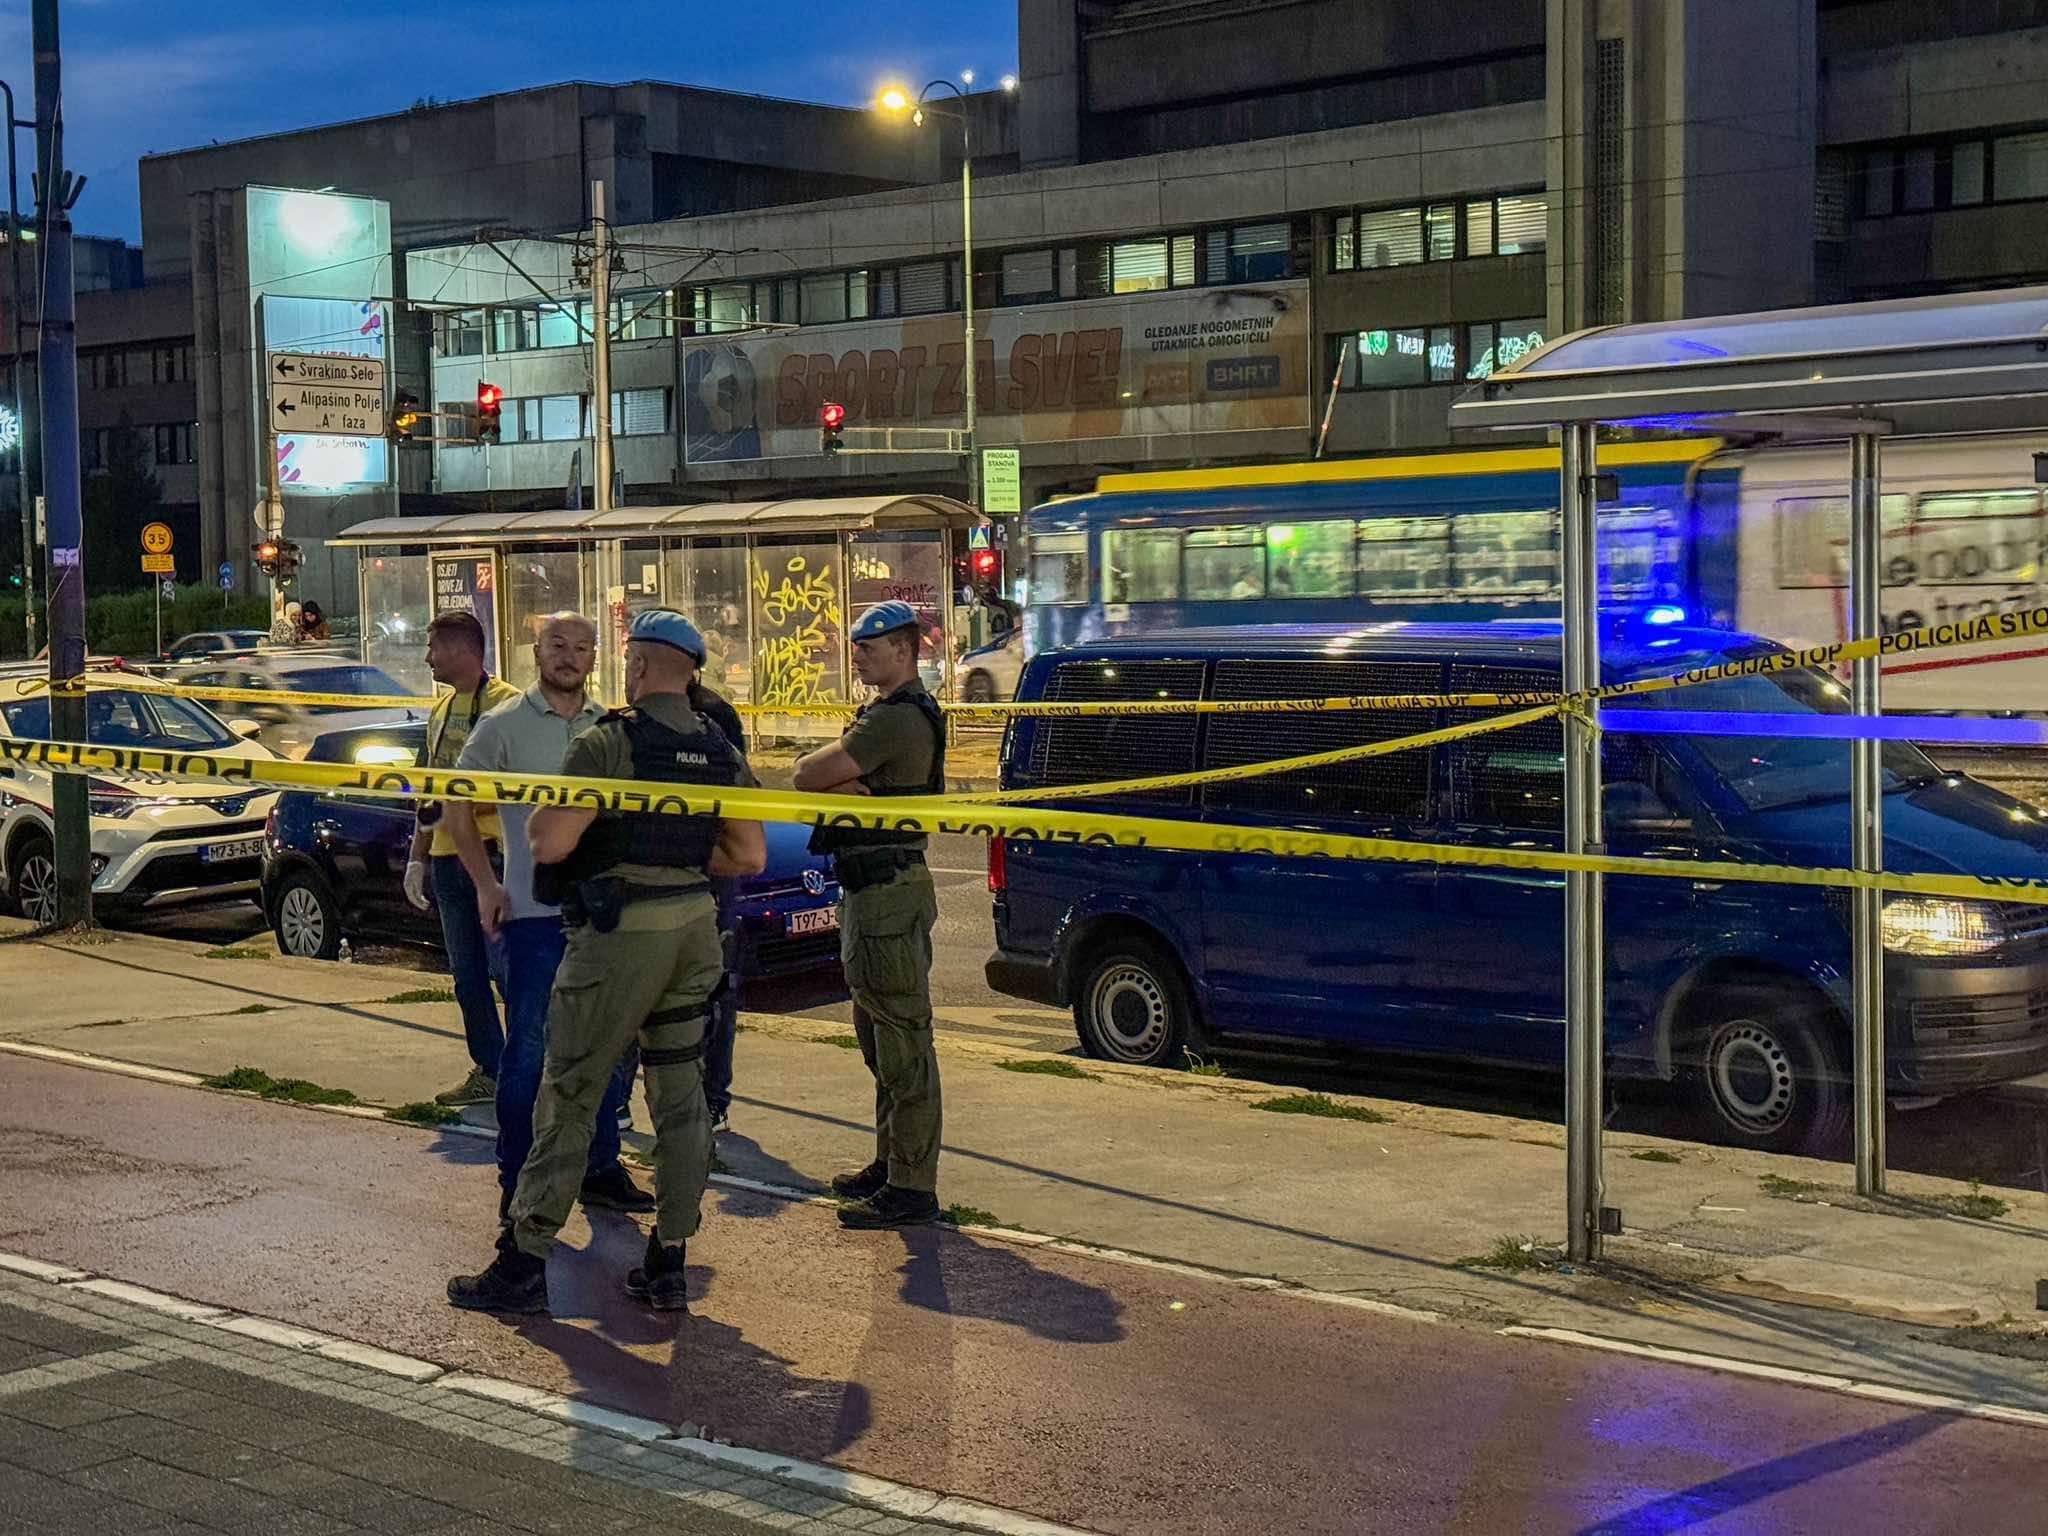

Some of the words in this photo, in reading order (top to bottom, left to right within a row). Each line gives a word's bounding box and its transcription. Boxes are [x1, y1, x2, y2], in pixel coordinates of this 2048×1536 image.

[1144, 324, 1198, 339] GLEDANJE
[1200, 317, 1274, 334] NOGOMETNIH
[1151, 337, 1206, 352] UTAKMICA
[350, 365, 374, 380] Selo
[777, 346, 927, 426] SPORT
[933, 340, 995, 415] ZA
[1007, 328, 1123, 410] SVE!
[1214, 364, 1273, 383] BHRT
[301, 391, 350, 410] Alipašino
[354, 393, 380, 412] Polje
[343, 414, 366, 429] faza
[455, 579, 464, 593] ZA
[1673, 655, 1774, 686] POLICIJA
[1781, 643, 1843, 670] STOP
[1879, 616, 1994, 655] POLICIJA
[2000, 606, 2048, 634] STO
[676, 751, 708, 765] POLICIJA
